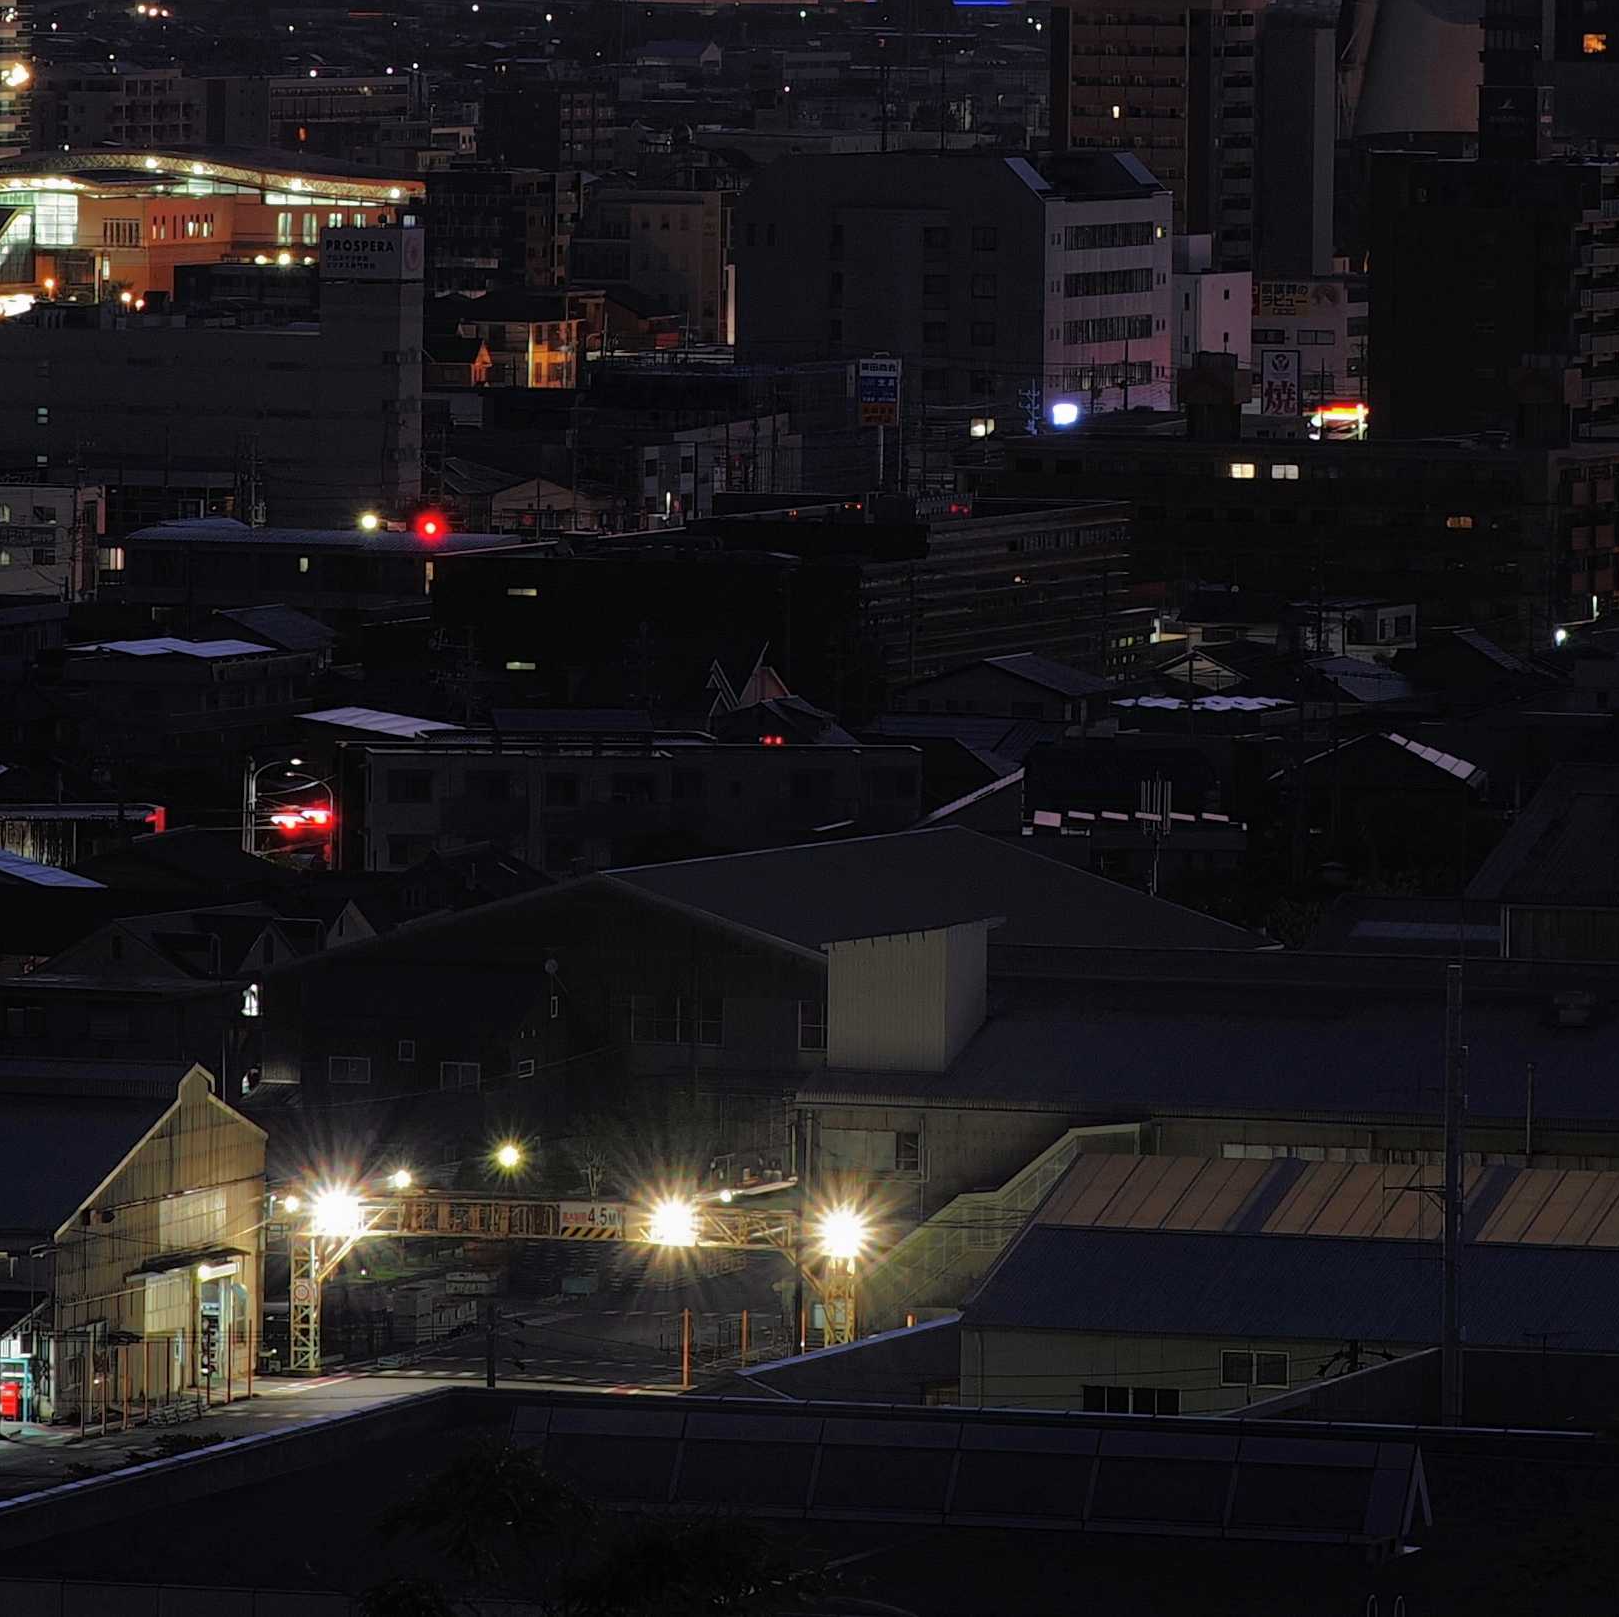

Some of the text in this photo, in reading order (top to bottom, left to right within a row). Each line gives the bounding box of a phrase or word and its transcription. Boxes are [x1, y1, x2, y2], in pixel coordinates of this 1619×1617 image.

[325, 239, 394, 252] PROSPERA
[1262, 295, 1307, 307] ラビュー
